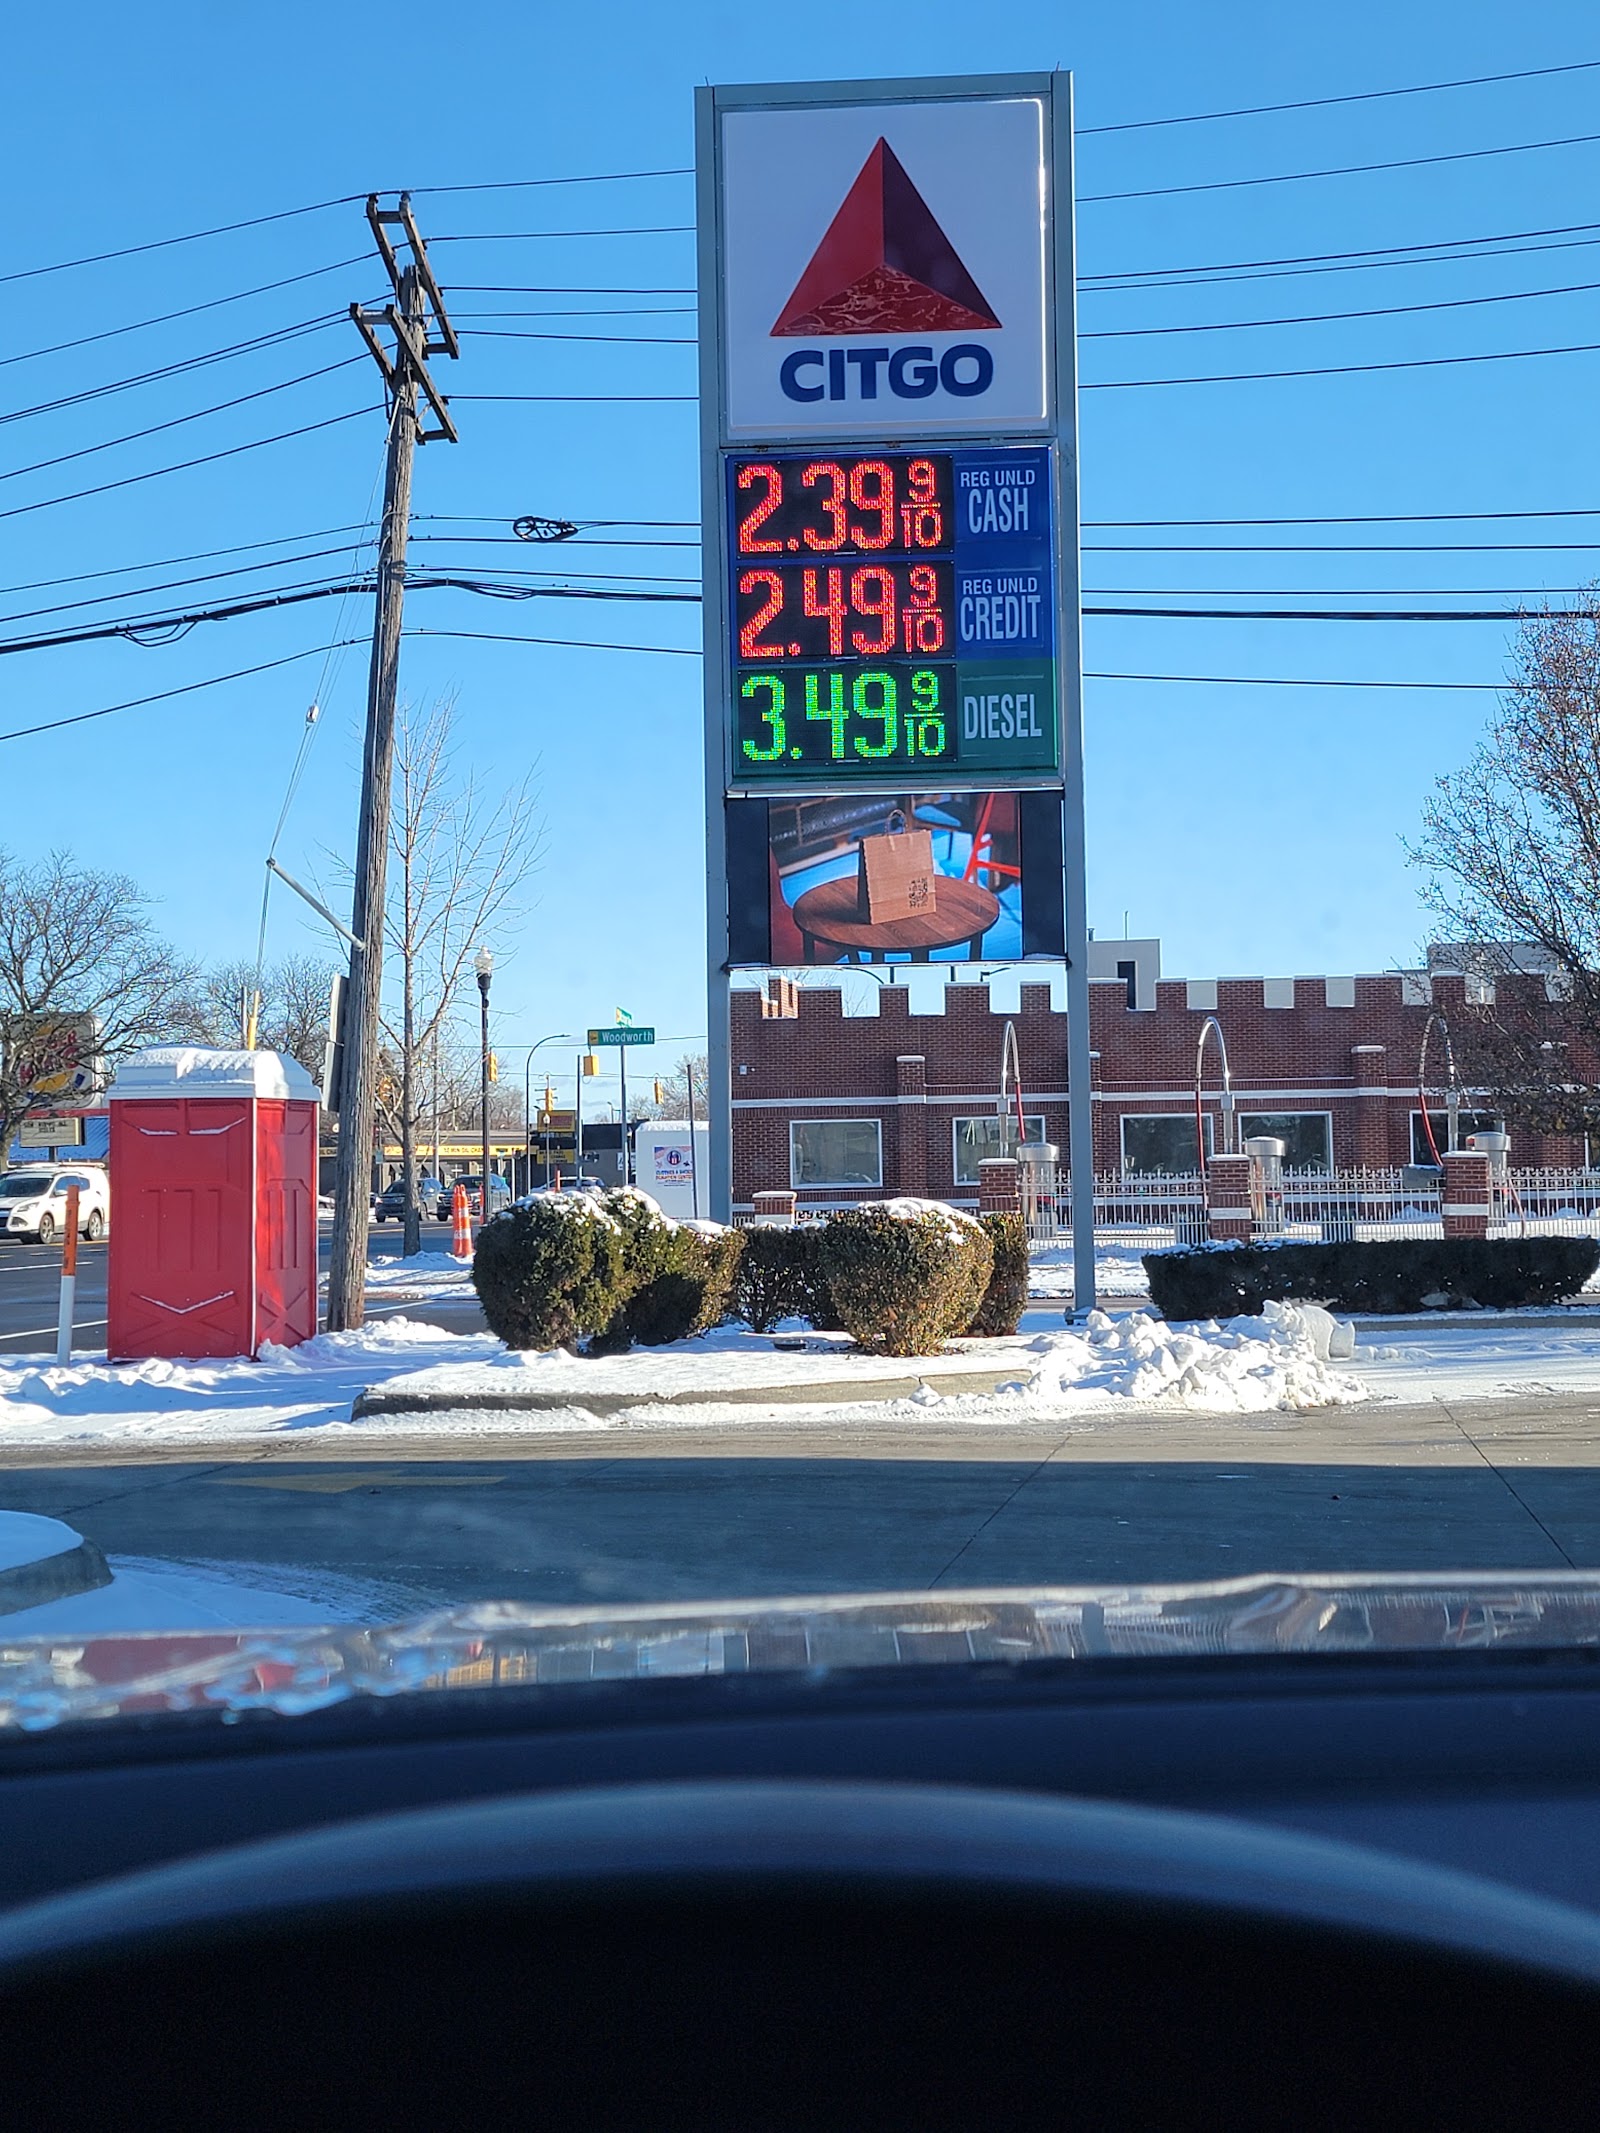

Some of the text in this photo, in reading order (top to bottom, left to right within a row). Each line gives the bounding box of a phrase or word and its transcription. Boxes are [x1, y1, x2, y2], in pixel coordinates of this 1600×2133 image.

[780, 343, 994, 403] CITGO
[908, 460, 935, 503] 9
[960, 469, 1036, 486] REG UNLD
[738, 461, 895, 552] 2.39
[968, 487, 1029, 534] CASH
[901, 508, 942, 548] 10
[909, 565, 936, 607] 9
[962, 577, 1038, 595] REG UNLD
[740, 567, 896, 658] 2.49
[902, 614, 943, 653] 10
[960, 595, 1041, 641] CREDIT
[911, 671, 939, 712] 9
[741, 672, 897, 761] 3.49
[904, 717, 946, 757] 10
[964, 693, 1043, 739] DIESEL
[602, 1031, 653, 1043] Woodworth
